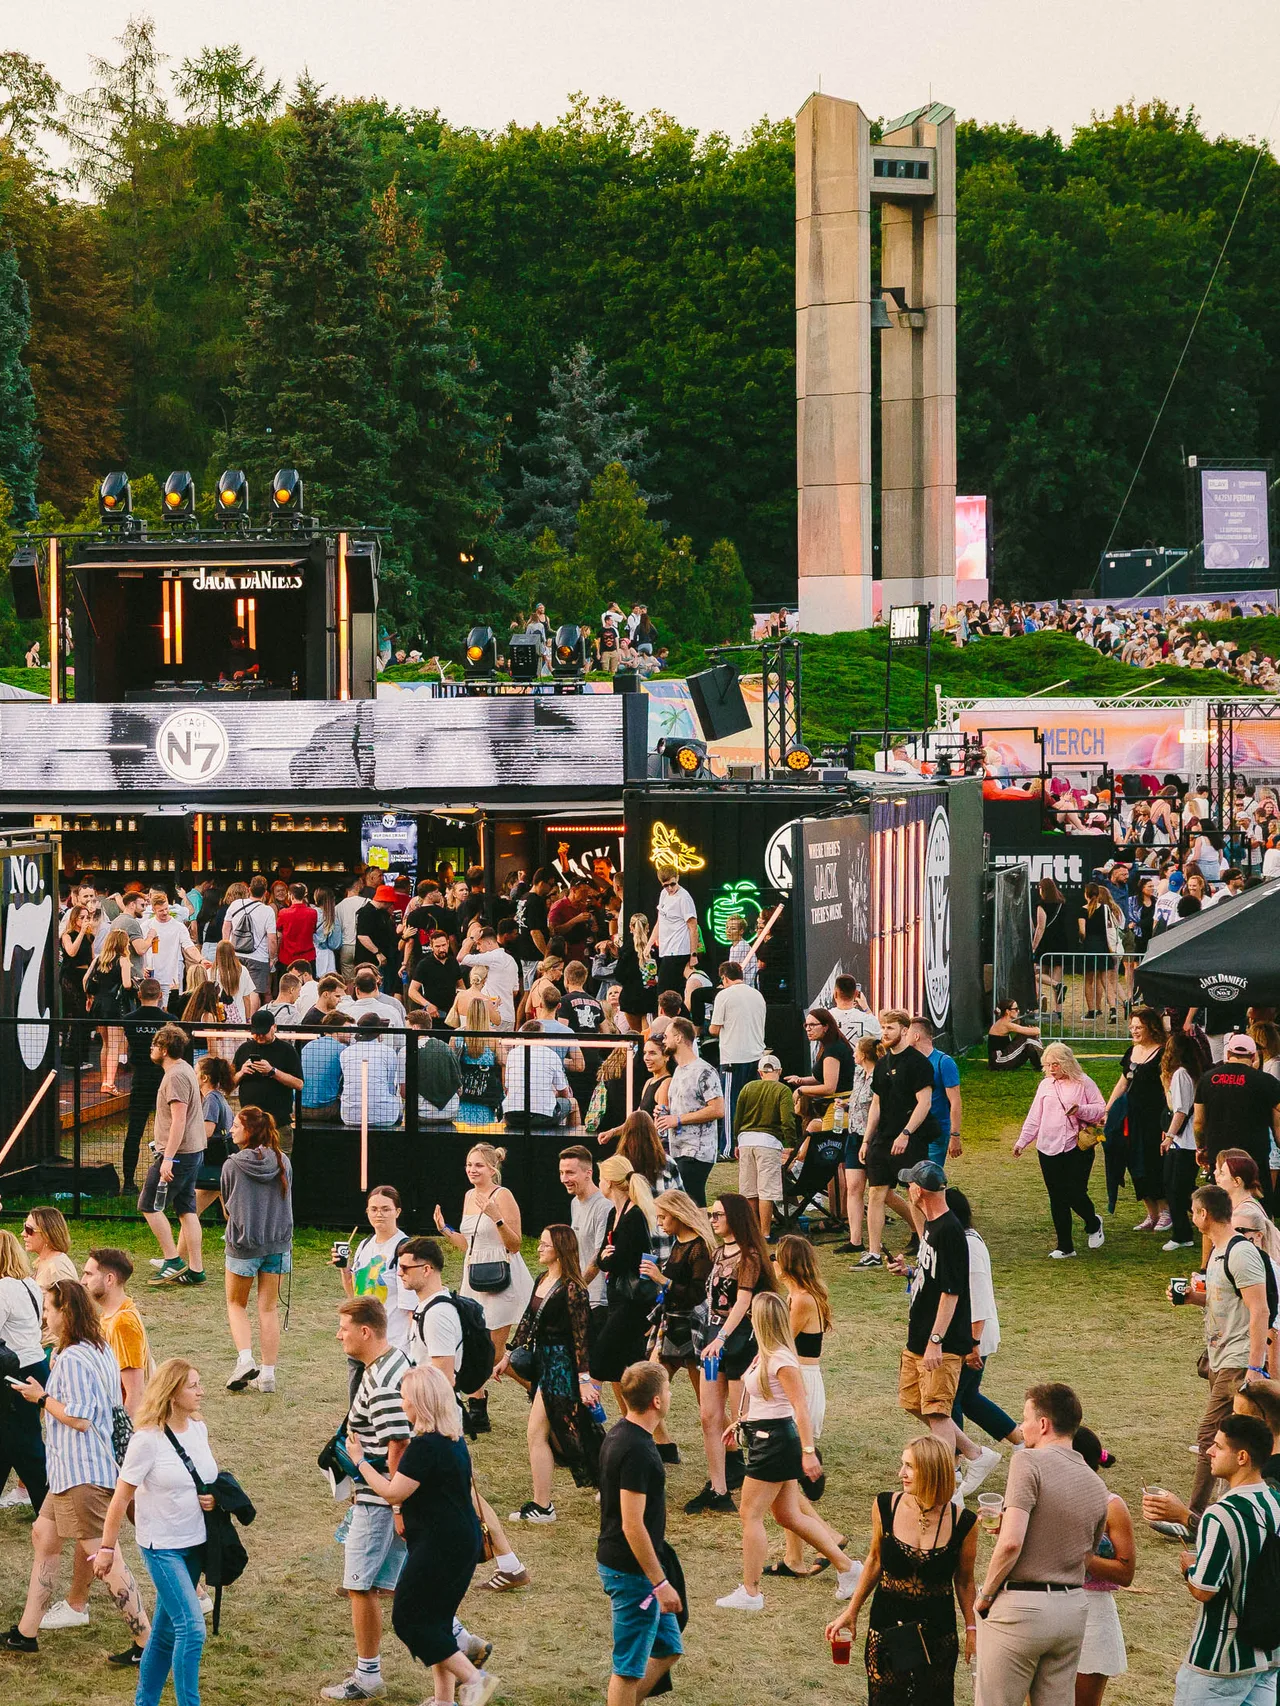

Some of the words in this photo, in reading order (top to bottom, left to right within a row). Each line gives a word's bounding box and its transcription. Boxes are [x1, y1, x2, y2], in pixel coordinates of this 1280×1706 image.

[177, 718, 207, 727] STAGE
[1042, 727, 1105, 756] MERCH
[9, 855, 45, 894] No.
[813, 862, 839, 902] JACK
[3, 894, 52, 1070] 7
[1199, 975, 1219, 989] JACK
[1218, 973, 1248, 989] DANIEL'S
